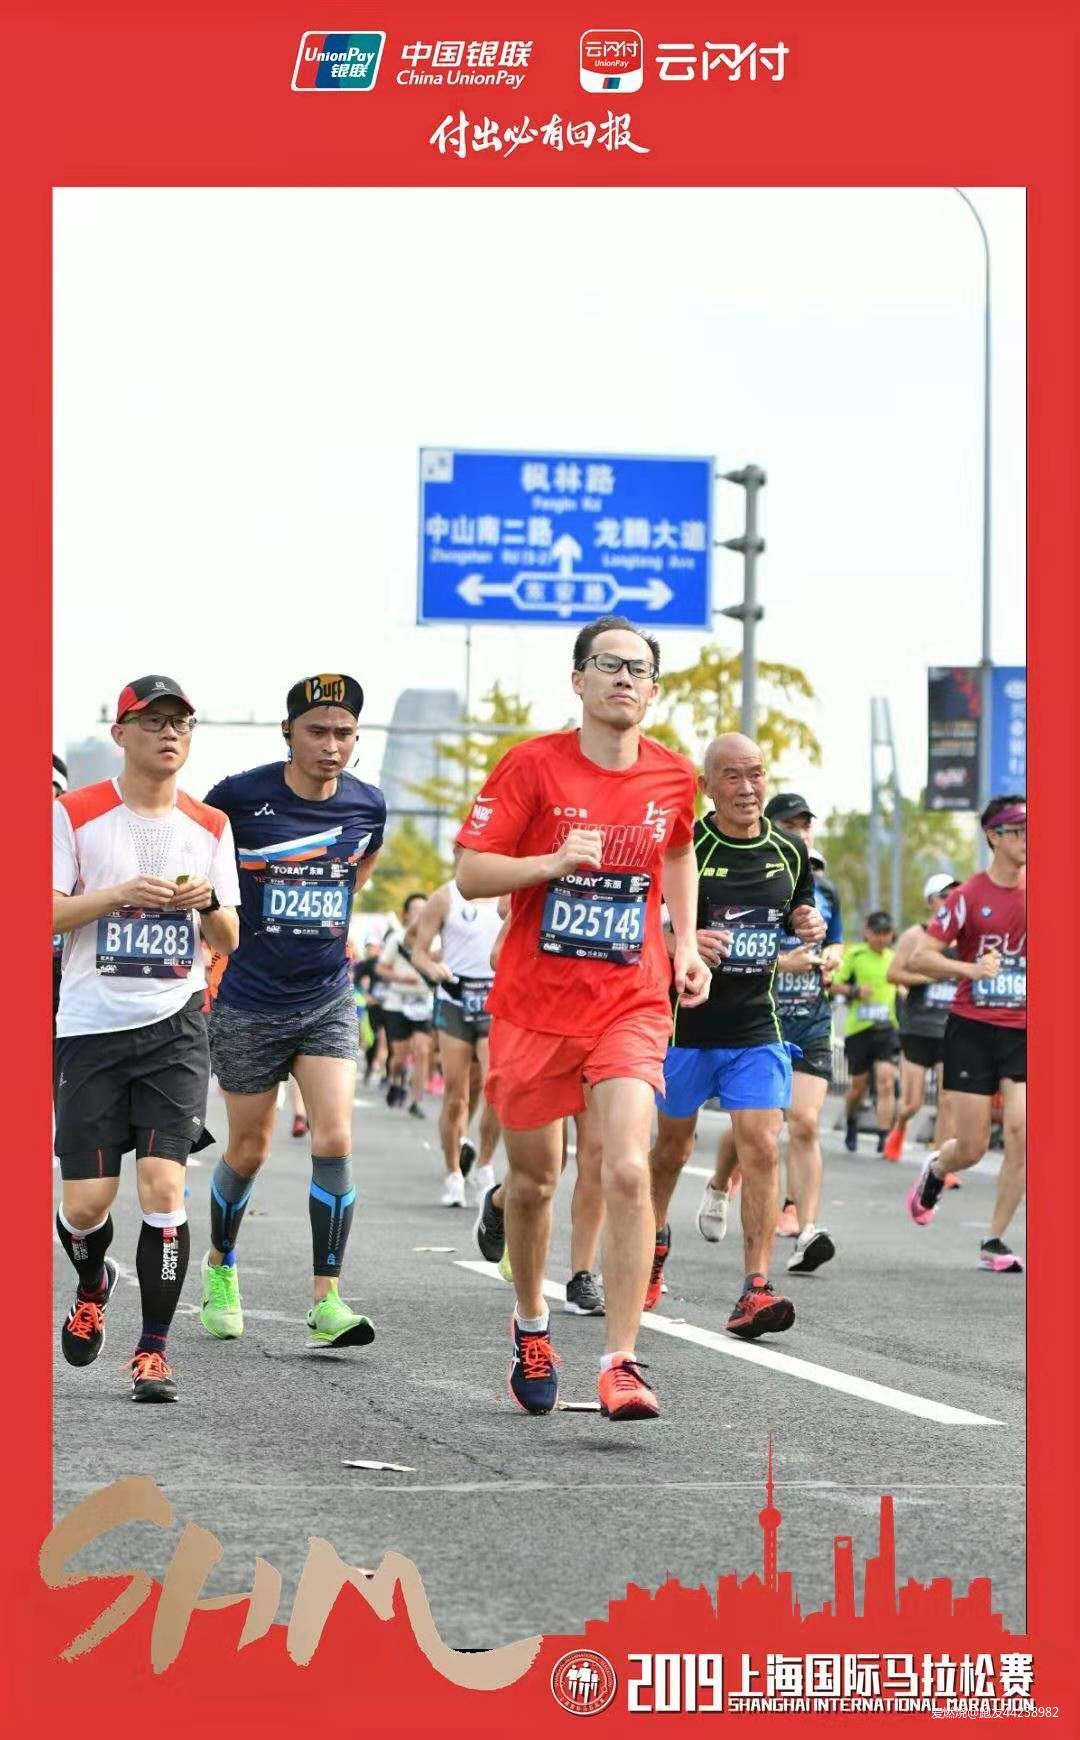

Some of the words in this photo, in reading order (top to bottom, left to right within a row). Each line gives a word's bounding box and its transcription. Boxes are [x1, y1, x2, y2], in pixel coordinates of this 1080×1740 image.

[427, 514, 553, 547] 中山南二路
[271, 889, 344, 919] D24582
[551, 900, 641, 940] D25145
[106, 922, 189, 956] B14283
[169, 1250, 178, 1281] SPORT
